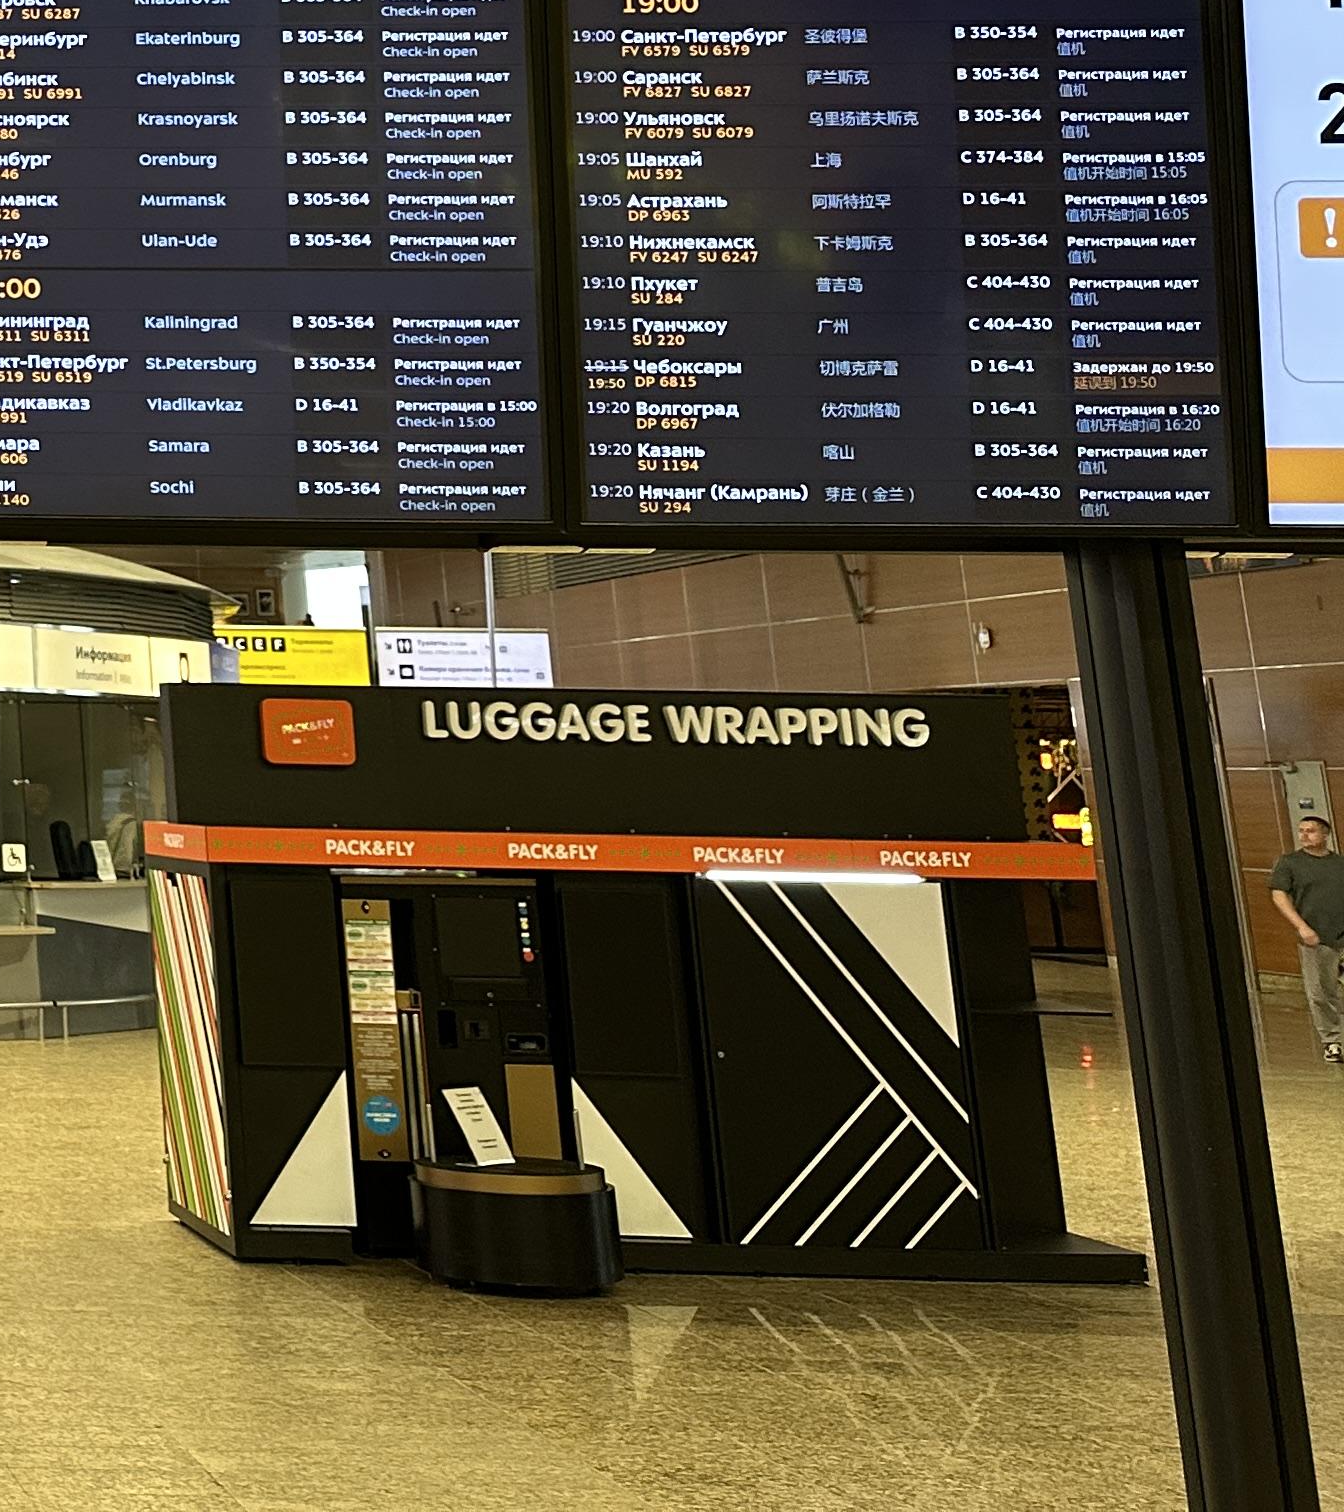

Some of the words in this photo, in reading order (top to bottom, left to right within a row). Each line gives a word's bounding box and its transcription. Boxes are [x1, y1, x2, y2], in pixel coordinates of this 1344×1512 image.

[138, 112, 238, 128] Krasnoyarsk
[626, 151, 702, 166] Шанхай
[811, 153, 842, 168] 上海
[631, 277, 698, 294] Пхукет
[818, 319, 848, 334] 广州
[147, 398, 243, 411] Vladikavkaz
[150, 480, 193, 493] Sochi
[255, 637, 265, 650] E
[273, 637, 283, 650] F
[423, 701, 652, 742] LUGGAGE
[663, 706, 929, 747] WRAPPING
[326, 839, 414, 856] PACK&FLY
[508, 843, 597, 859] PACK&FLY
[694, 847, 784, 864] PACK&FLY
[880, 851, 971, 867] PACK&FLY
